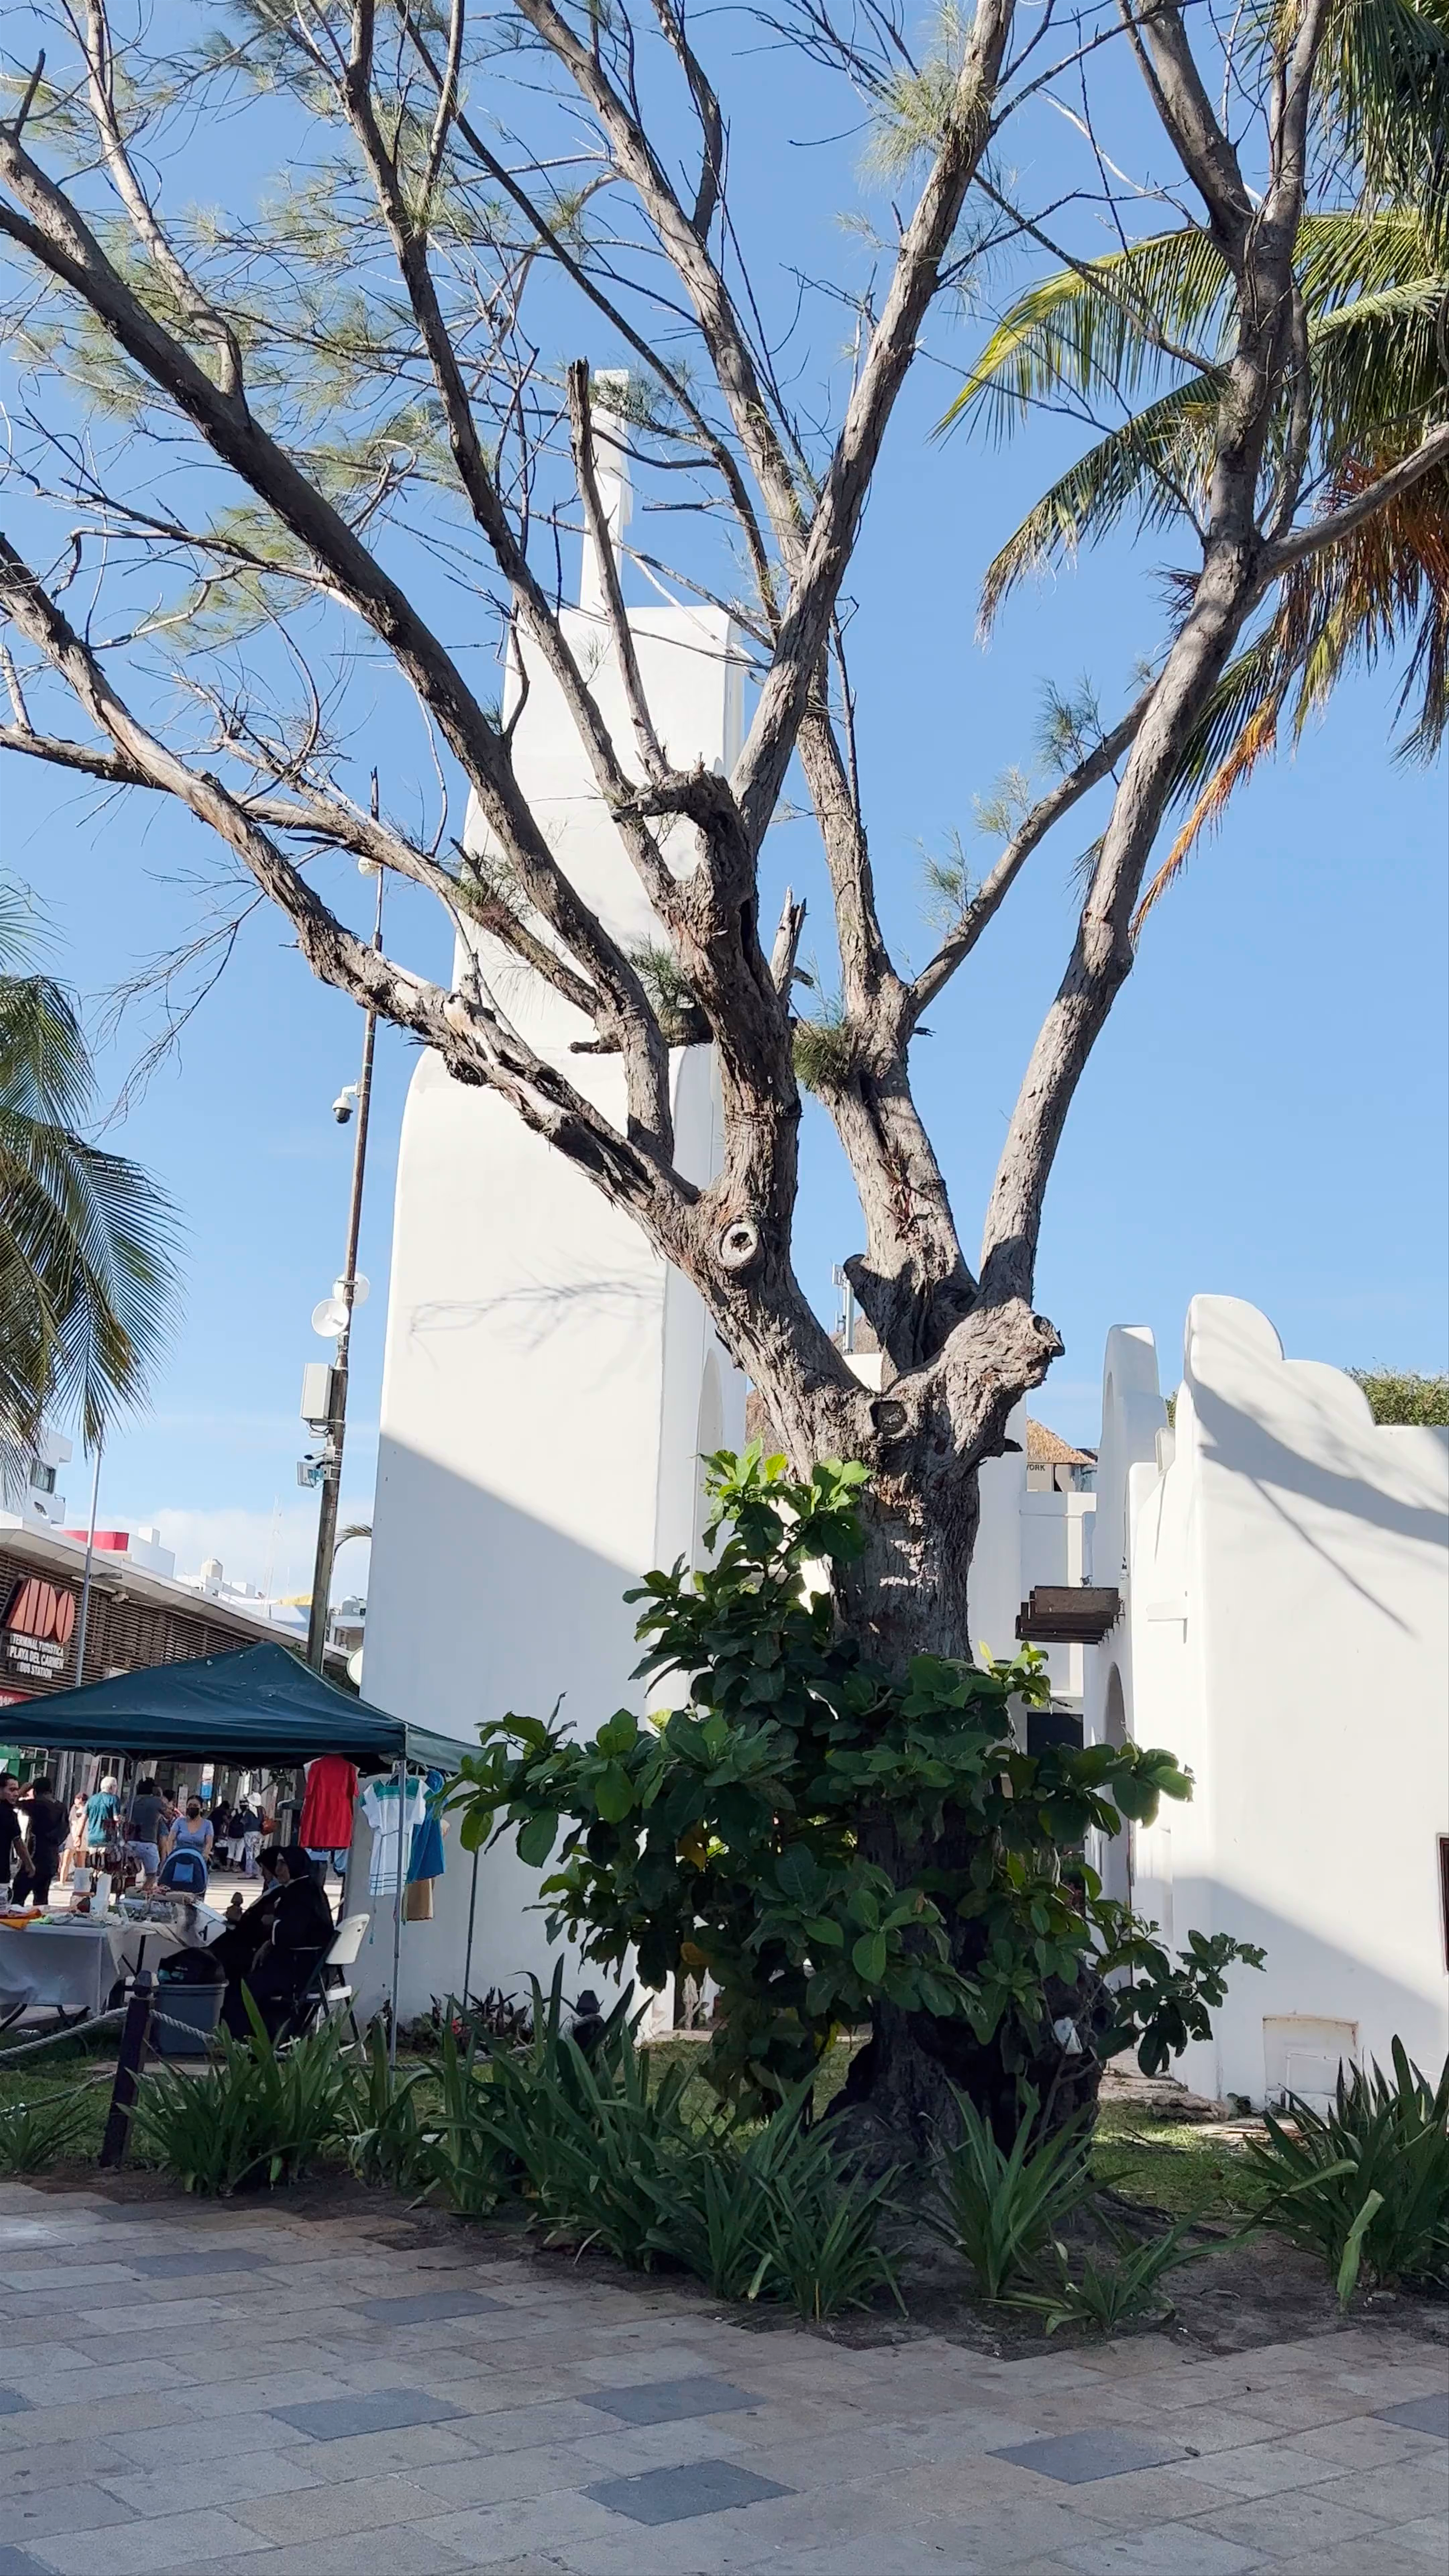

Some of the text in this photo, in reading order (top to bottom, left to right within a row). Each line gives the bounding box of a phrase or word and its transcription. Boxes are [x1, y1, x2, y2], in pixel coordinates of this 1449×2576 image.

[10, 1578, 75, 1642] ADO
[11, 1633, 38, 1650] TERMINAL
[9, 1646, 64, 1670] PLAYA DEL CARMEN
[18, 1662, 52, 1679] BUS STATION
